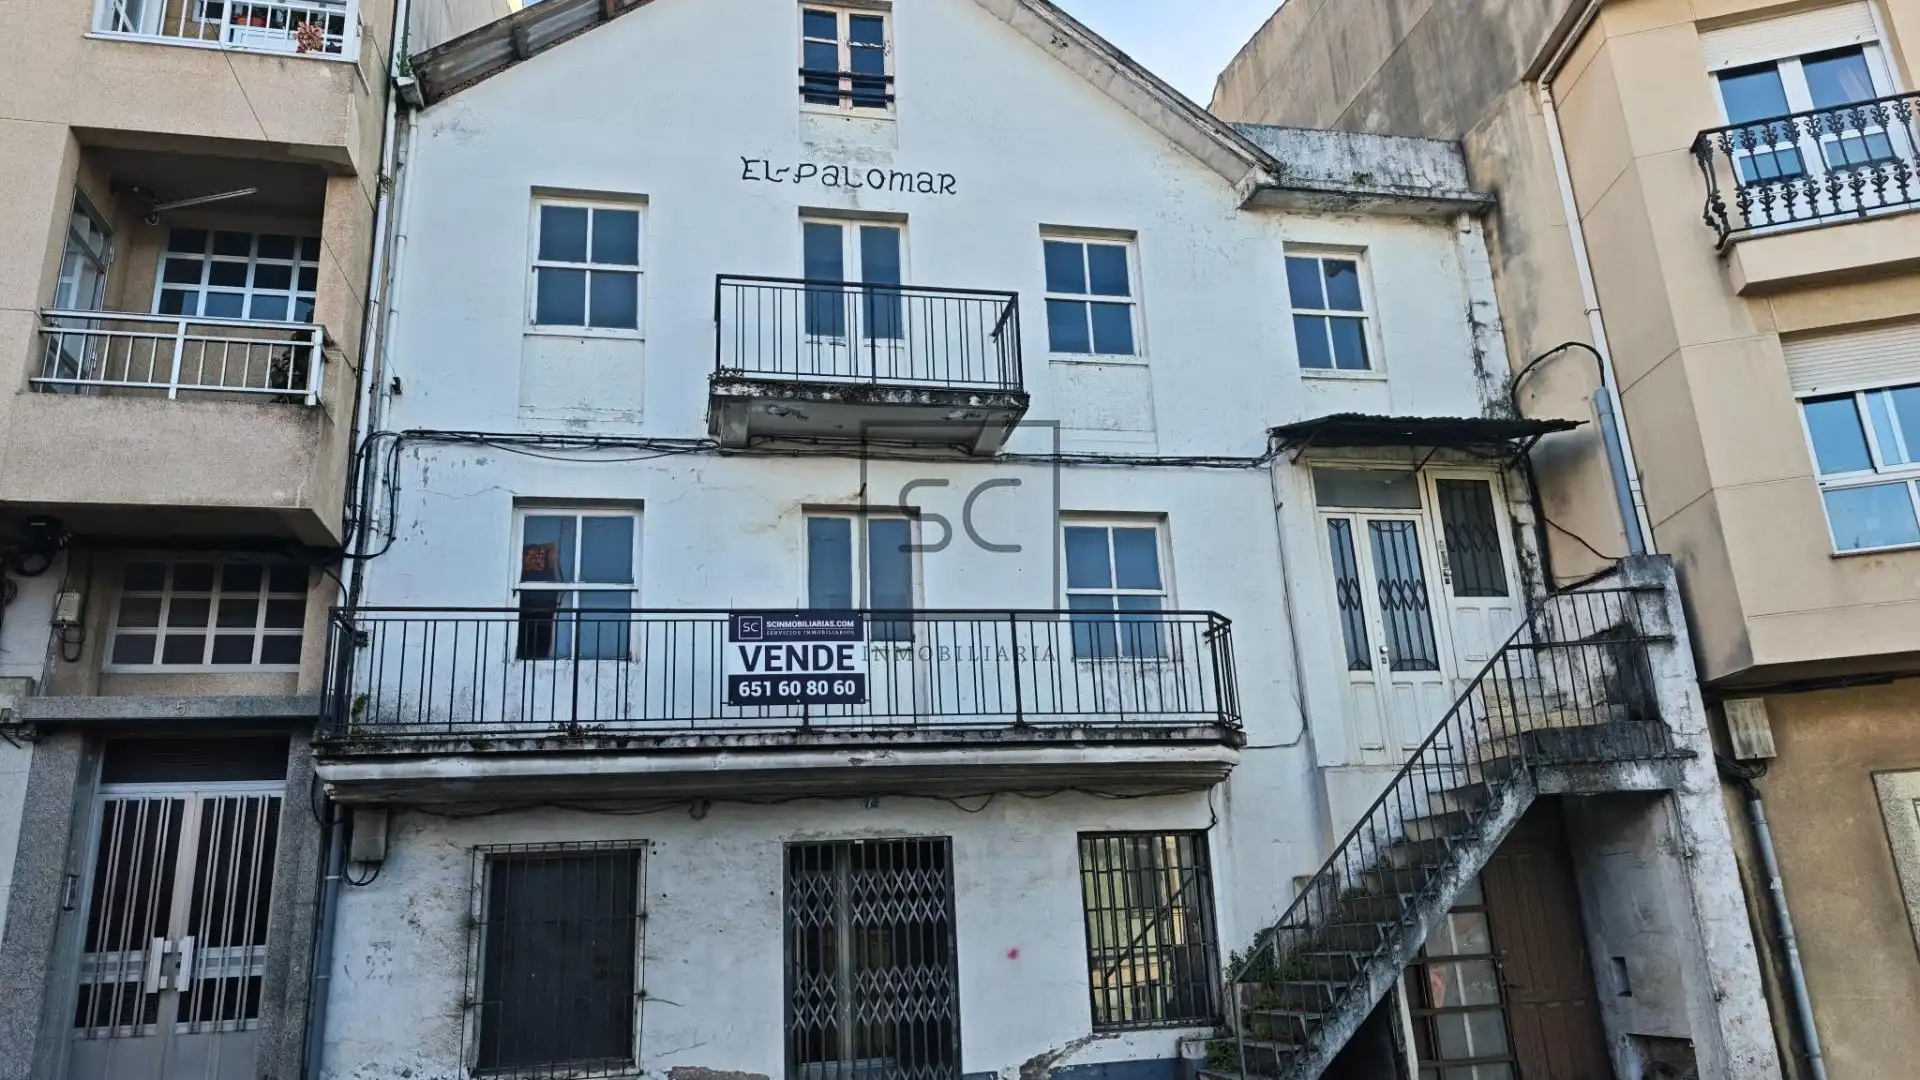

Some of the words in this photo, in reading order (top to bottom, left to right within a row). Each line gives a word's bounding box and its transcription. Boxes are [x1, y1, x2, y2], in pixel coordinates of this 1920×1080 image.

[742, 621, 759, 632] SC
[766, 620, 855, 628] SCINMOBILIARIAS.COM
[738, 644, 855, 672] VENDE
[738, 681, 772, 697] 651
[778, 681, 801, 696] 60
[806, 680, 829, 696] 80
[833, 679, 856, 696] 60
